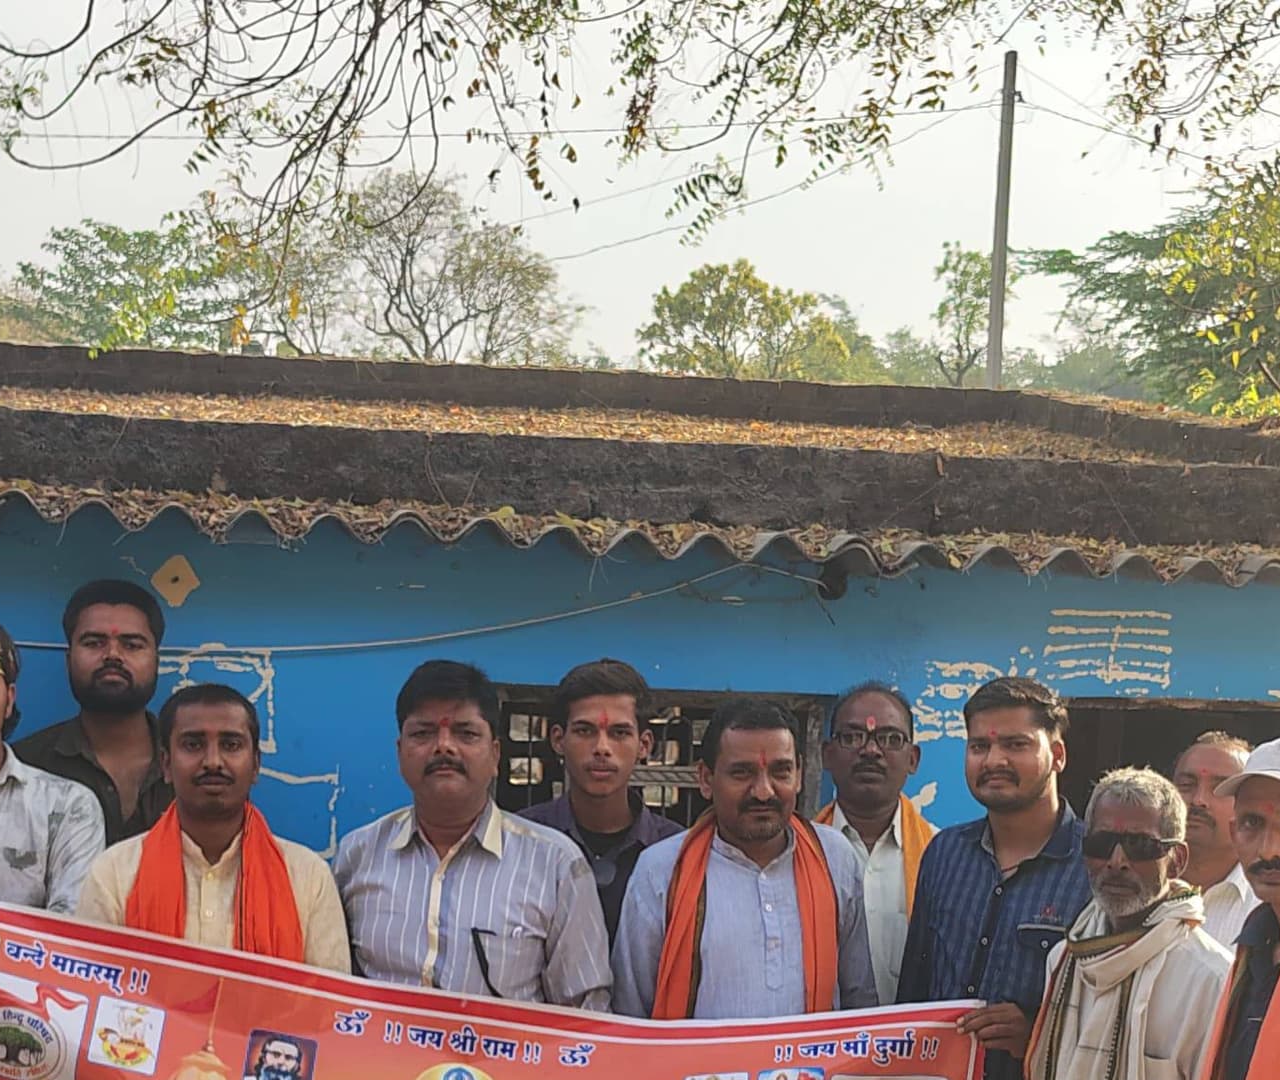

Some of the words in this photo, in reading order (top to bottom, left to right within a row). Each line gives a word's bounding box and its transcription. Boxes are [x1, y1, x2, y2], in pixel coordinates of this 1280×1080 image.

[6, 939, 46, 970] वन्दे
[51, 954, 124, 993] मातरम्
[408, 1025, 444, 1050] जय
[449, 1025, 478, 1055] श्री
[482, 1034, 517, 1061] राम
[800, 1042, 836, 1057] जय
[842, 1032, 869, 1056] माँ
[873, 1030, 915, 1064] दुर्गा
